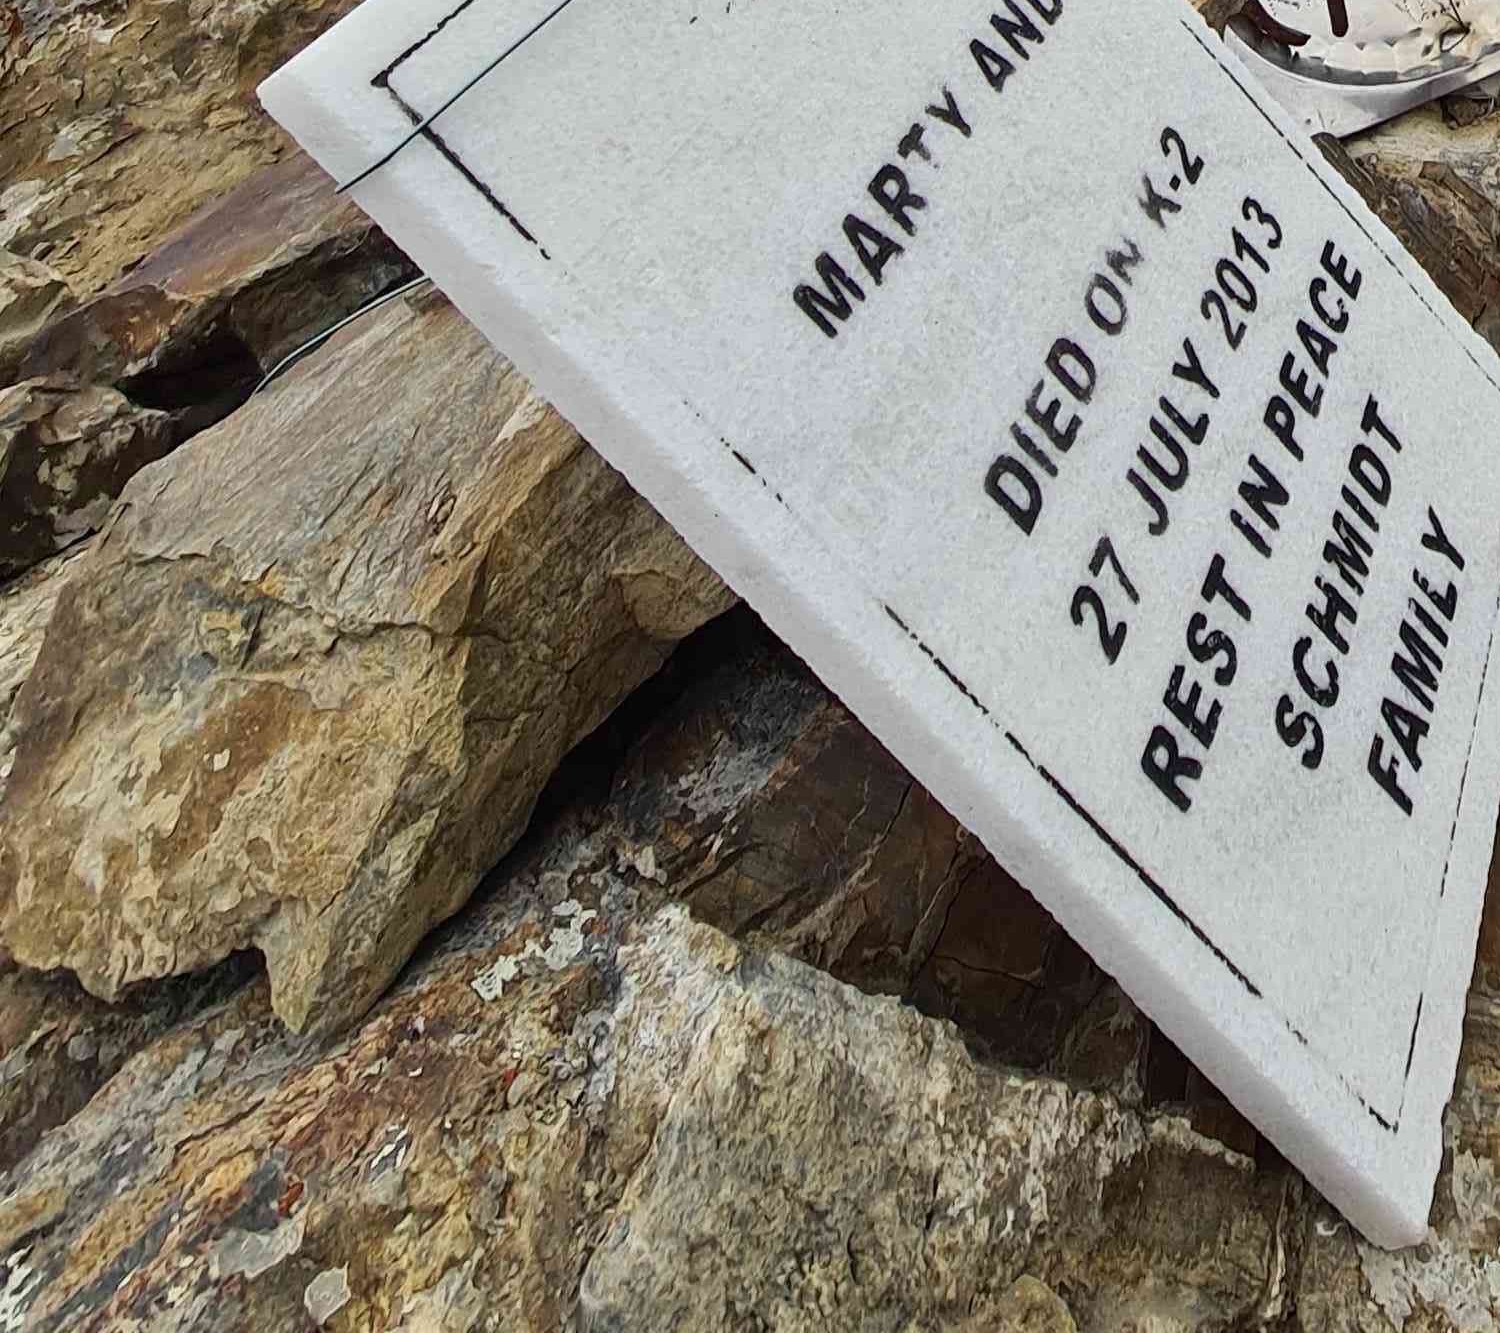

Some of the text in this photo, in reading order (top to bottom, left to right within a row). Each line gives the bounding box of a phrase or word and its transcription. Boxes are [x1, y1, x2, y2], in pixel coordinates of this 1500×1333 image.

[792, 85, 974, 340] MARTY
[981, 123, 1209, 538] DIED ON K-2
[1068, 194, 1287, 667] 27 JULY 2013
[1137, 237, 1368, 813] REST IN PEACE
[1272, 390, 1409, 773] SCHMIDT
[1365, 505, 1471, 818] FAMILY
